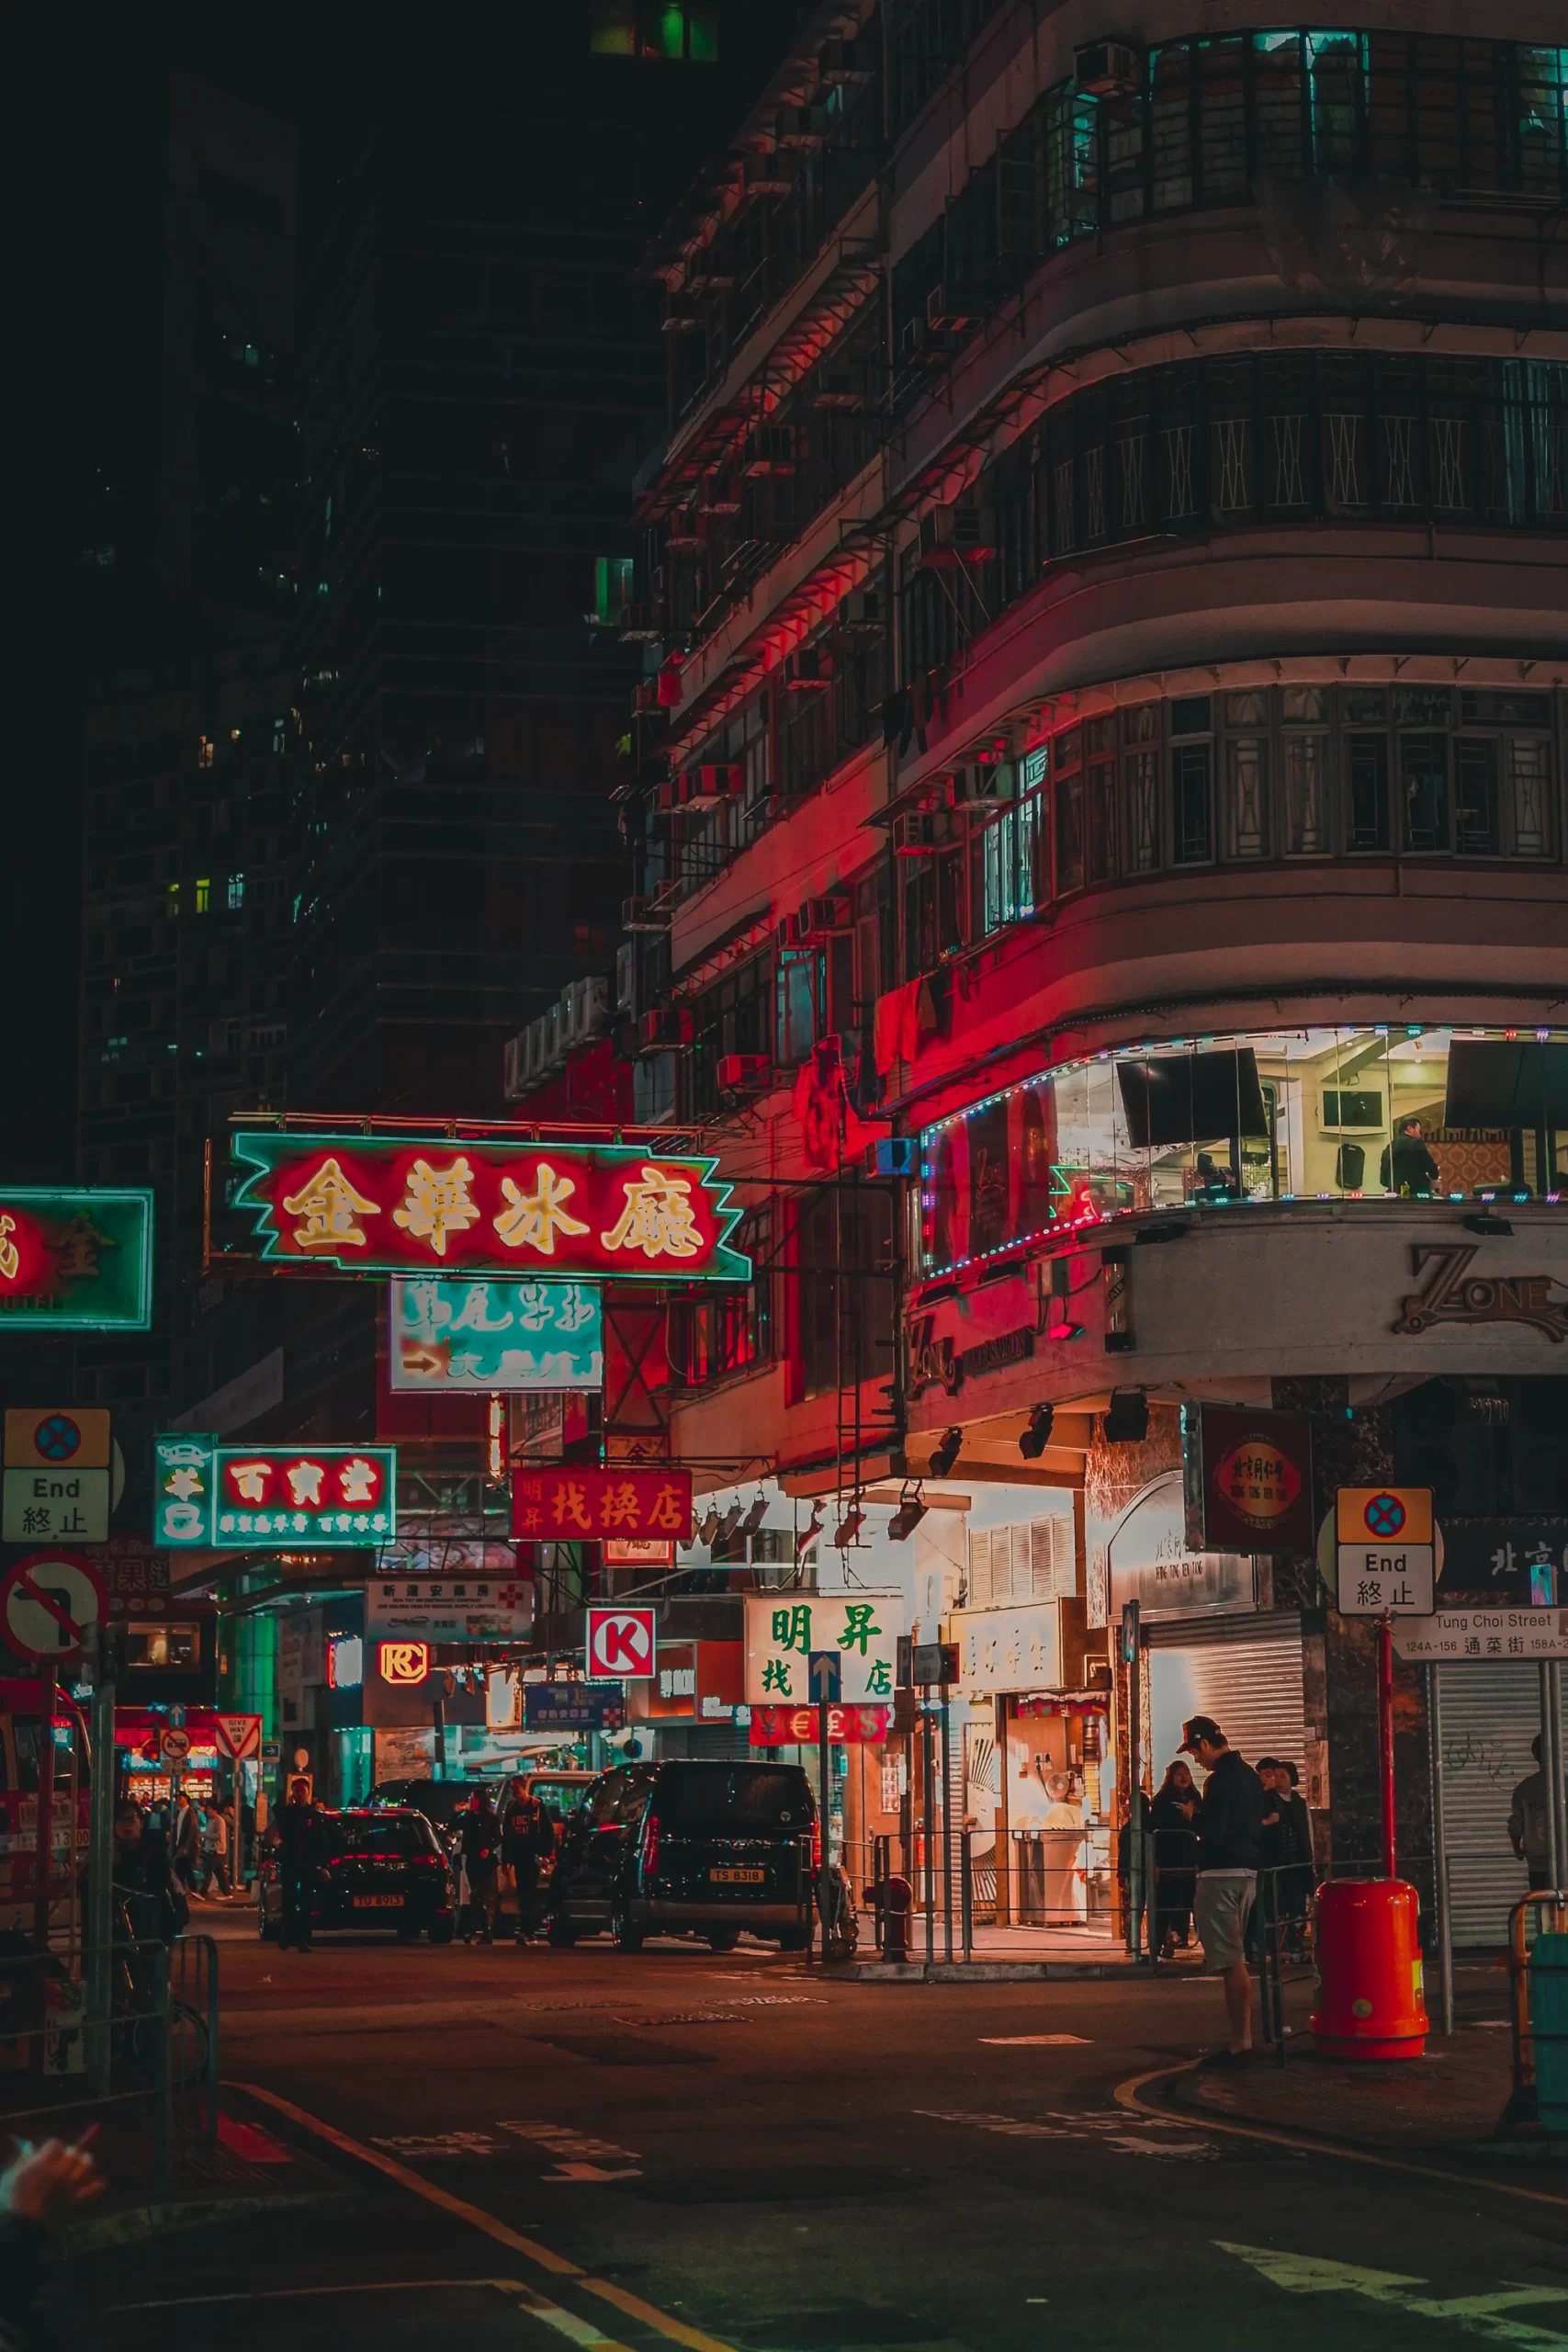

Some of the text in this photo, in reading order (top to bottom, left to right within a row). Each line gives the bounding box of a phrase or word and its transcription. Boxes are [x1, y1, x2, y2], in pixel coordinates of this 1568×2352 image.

[283, 1158, 704, 1259] 金華冰廳
[34, 1478, 80, 1498] End
[521, 1479, 544, 1533] 明昇
[551, 1480, 684, 1531] 找換店
[23, 1507, 88, 1534] 終止
[1365, 1554, 1406, 1572] End
[1357, 1580, 1415, 1606] 終止
[772, 1603, 882, 1657] 明昇
[1436, 1613, 1551, 1631] Tung Choi Street
[1464, 1636, 1525, 1655] 通菜街
[761, 1659, 892, 1698] 找店
[715, 1870, 759, 1880] TS 8318
